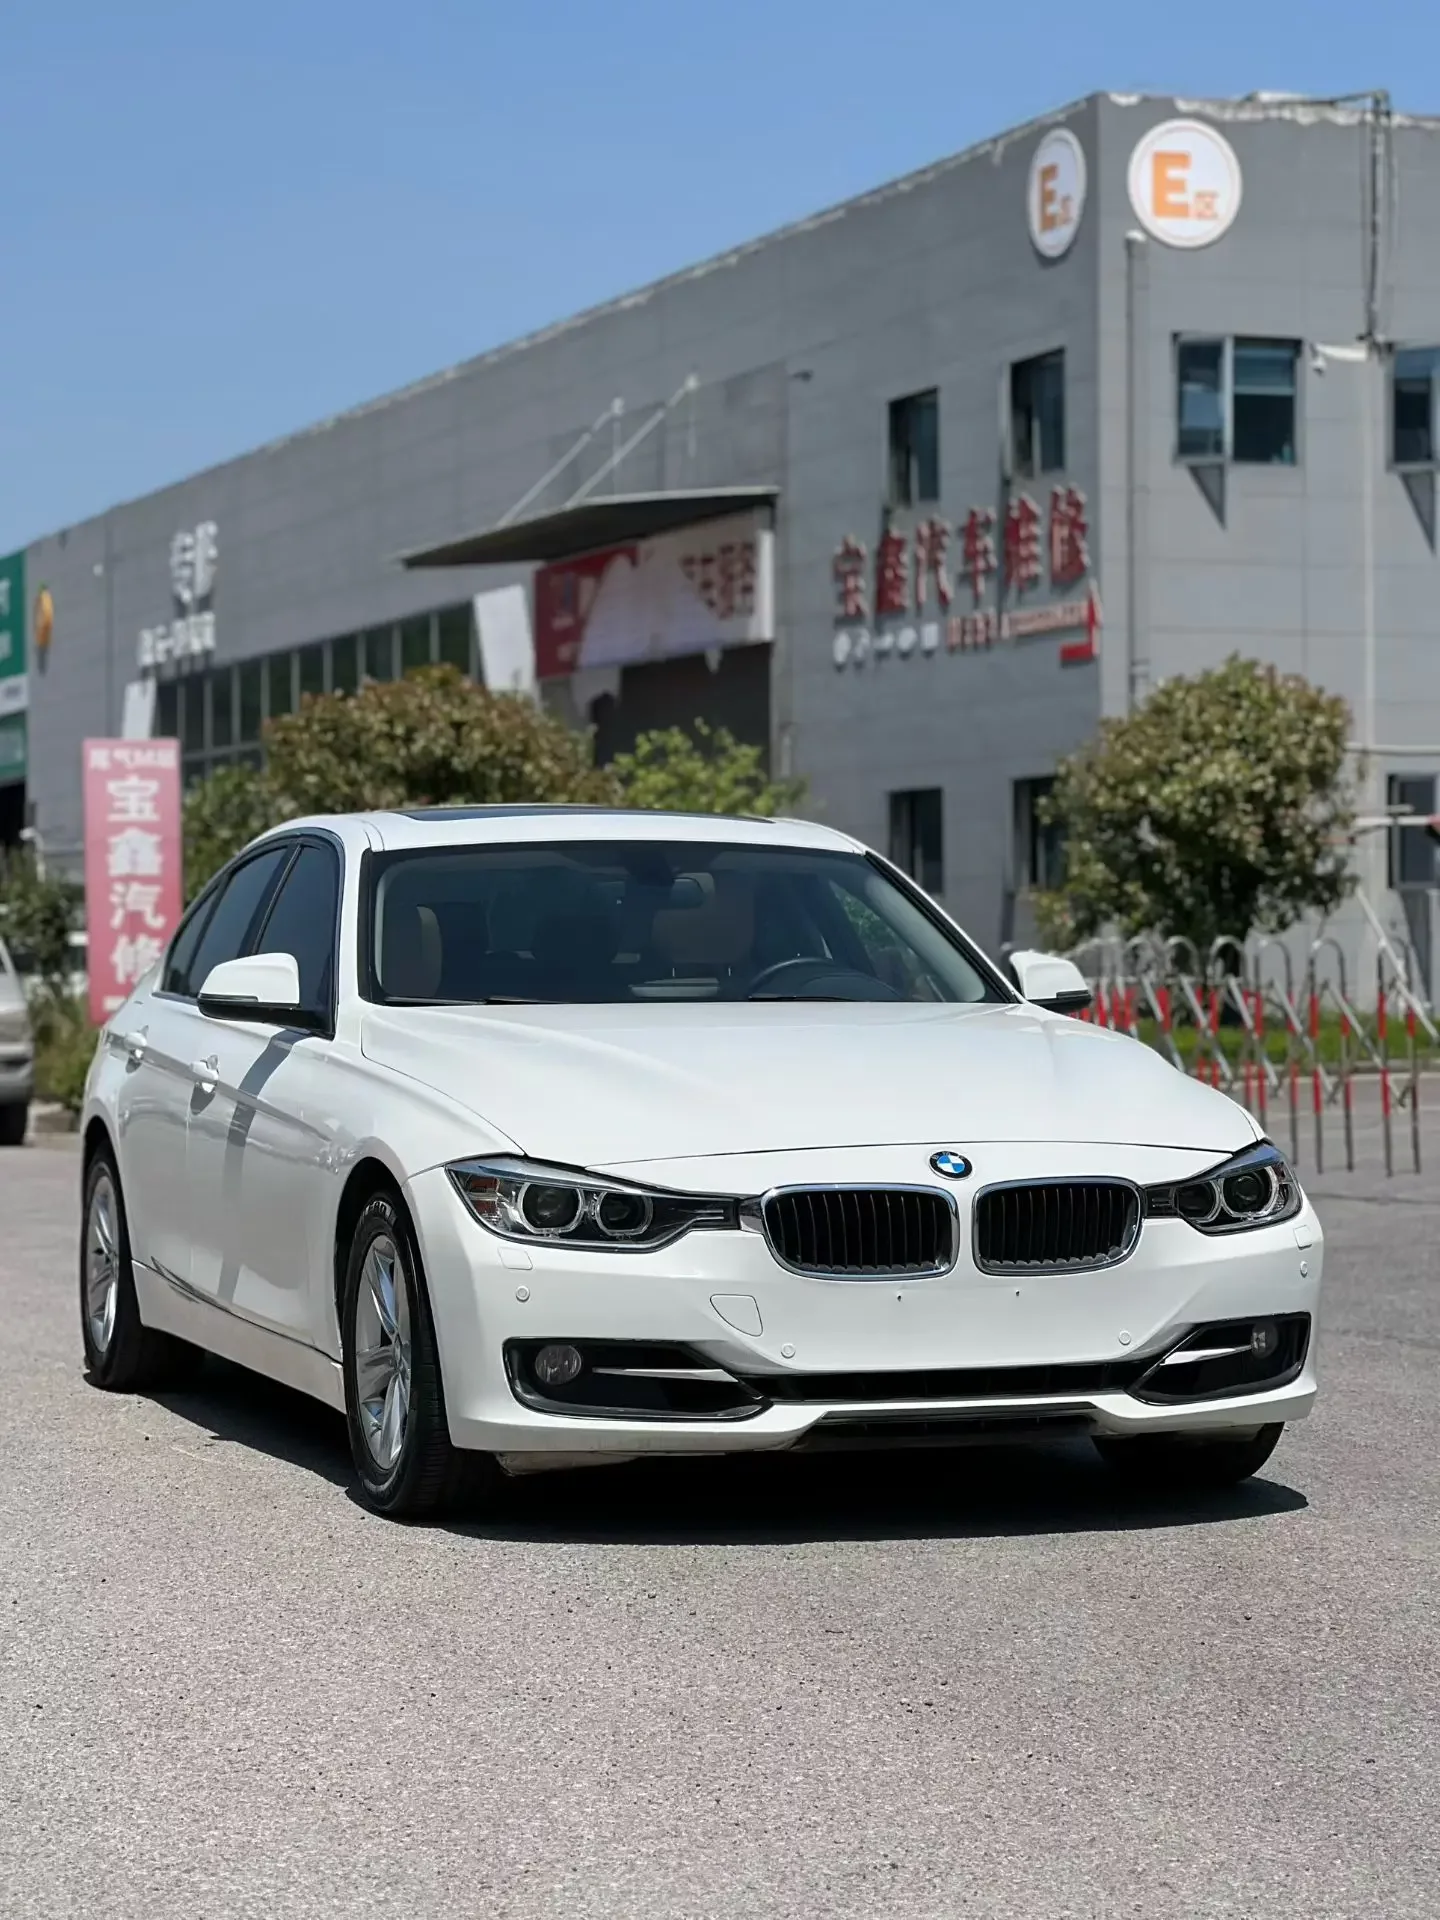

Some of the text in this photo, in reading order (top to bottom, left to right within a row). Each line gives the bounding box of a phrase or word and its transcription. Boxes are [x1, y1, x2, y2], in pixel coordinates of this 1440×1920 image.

[1152, 150, 1220, 220] E区
[105, 773, 166, 985] 宝鑫汽修
